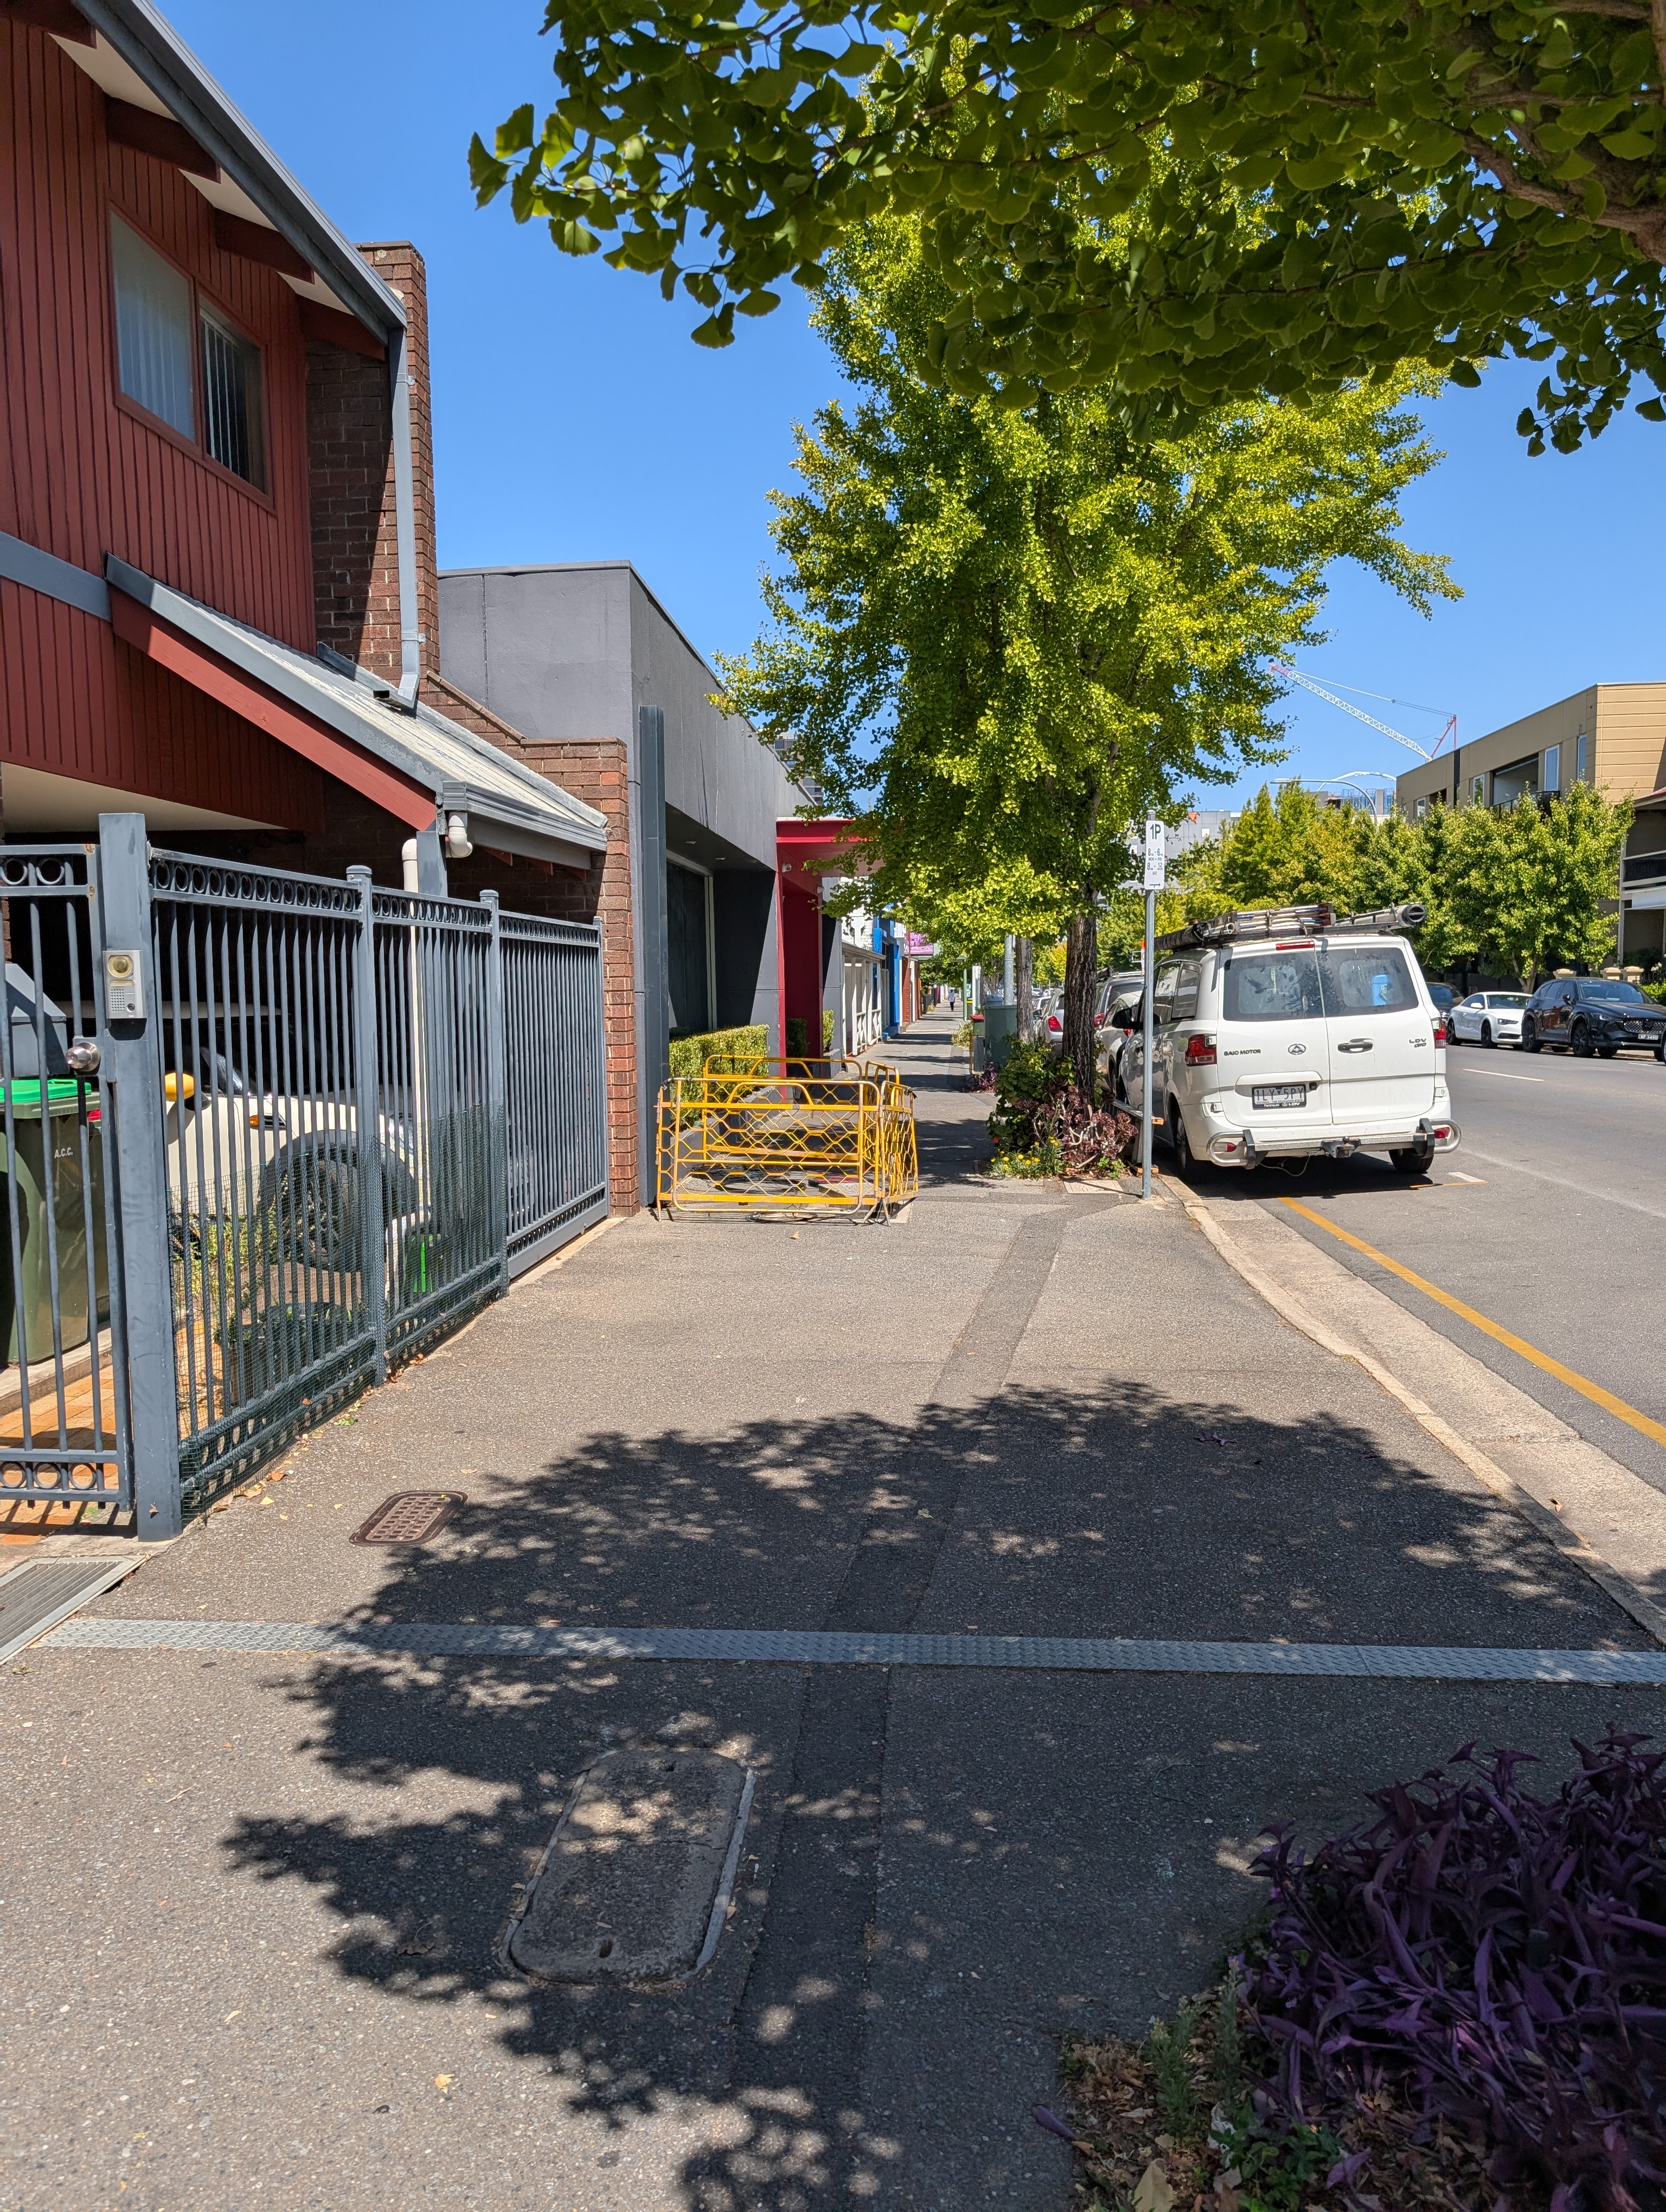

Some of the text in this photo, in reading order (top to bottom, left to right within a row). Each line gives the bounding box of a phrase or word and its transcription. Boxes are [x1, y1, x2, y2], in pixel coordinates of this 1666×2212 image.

[1150, 824, 1161, 839] 1P
[1256, 1088, 1303, 1101] 1LY 5PY
[54, 1147, 73, 1159] A.C.C.
